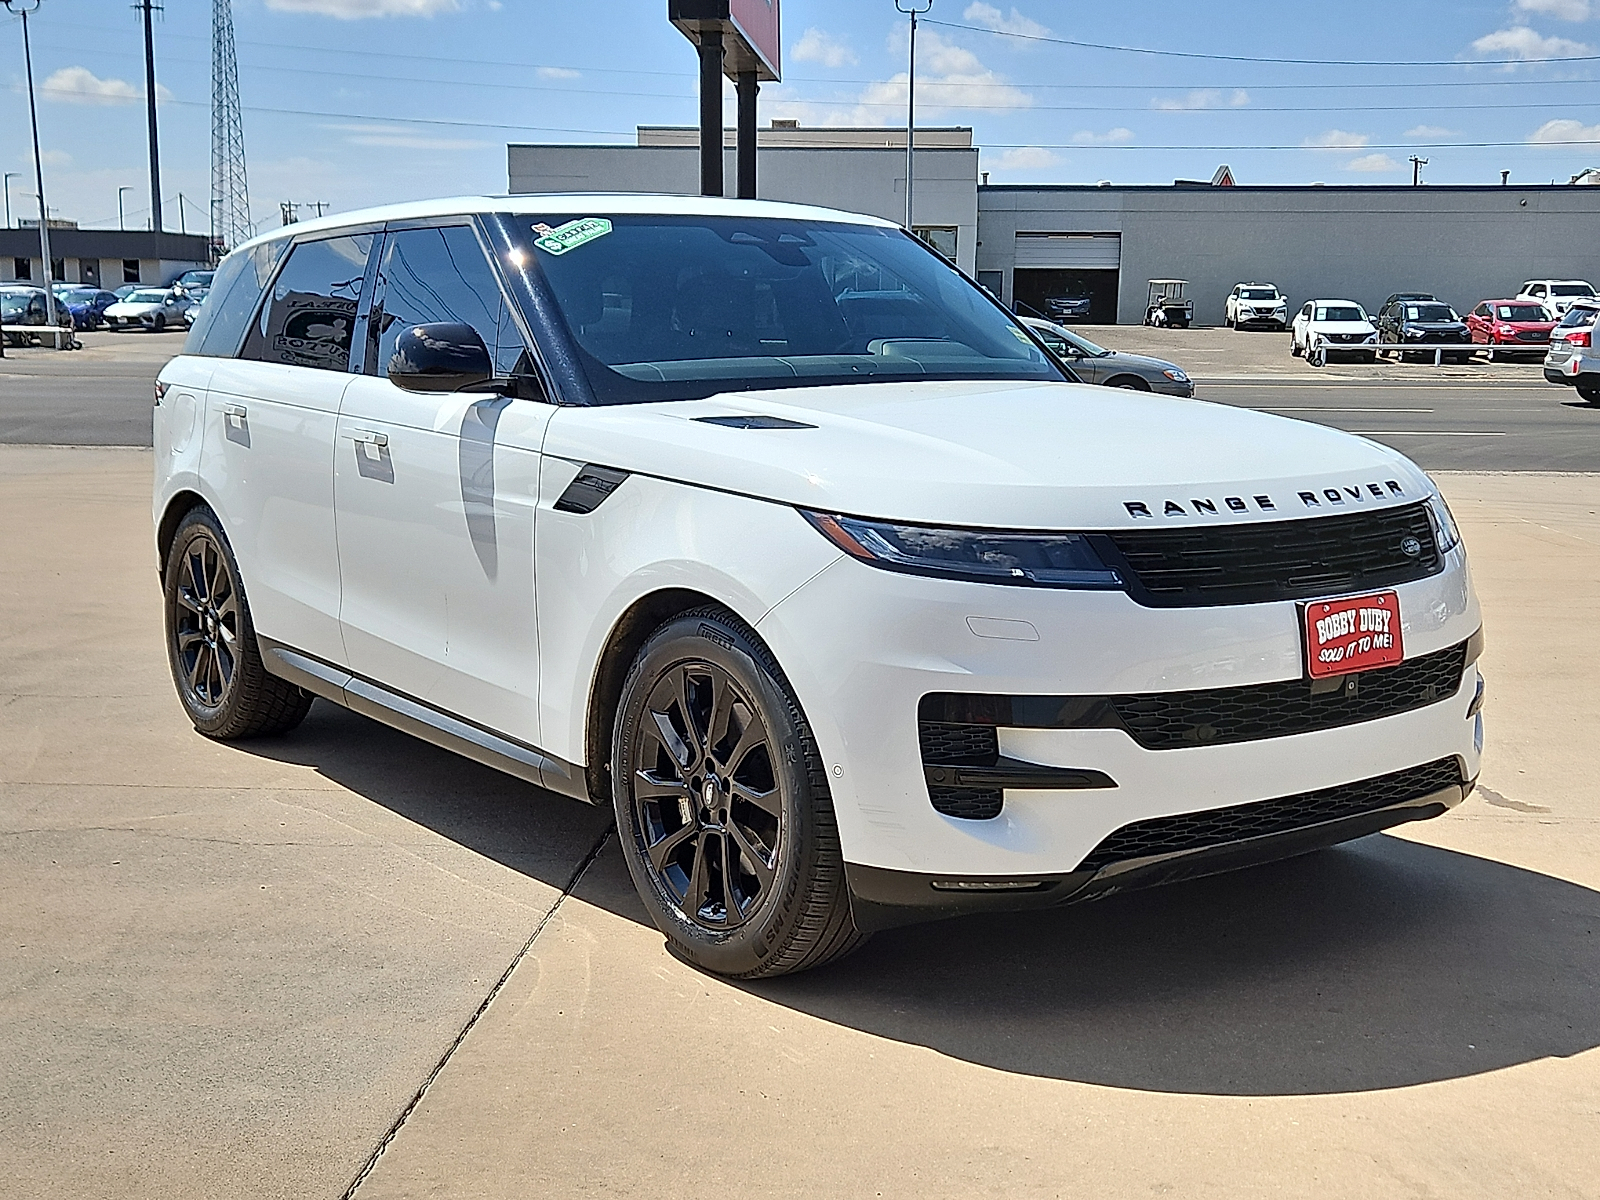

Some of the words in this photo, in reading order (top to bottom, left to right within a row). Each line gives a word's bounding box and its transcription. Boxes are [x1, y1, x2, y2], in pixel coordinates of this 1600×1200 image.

[1122, 495, 1278, 518] RANGE
[1297, 480, 1406, 508] ROVER
[1316, 609, 1356, 645] BOBBY
[1359, 608, 1392, 633] DUBY
[1318, 646, 1345, 663] SOLD
[1346, 641, 1358, 659] IT
[1358, 636, 1371, 654] TO
[1372, 633, 1393, 650] ME!
